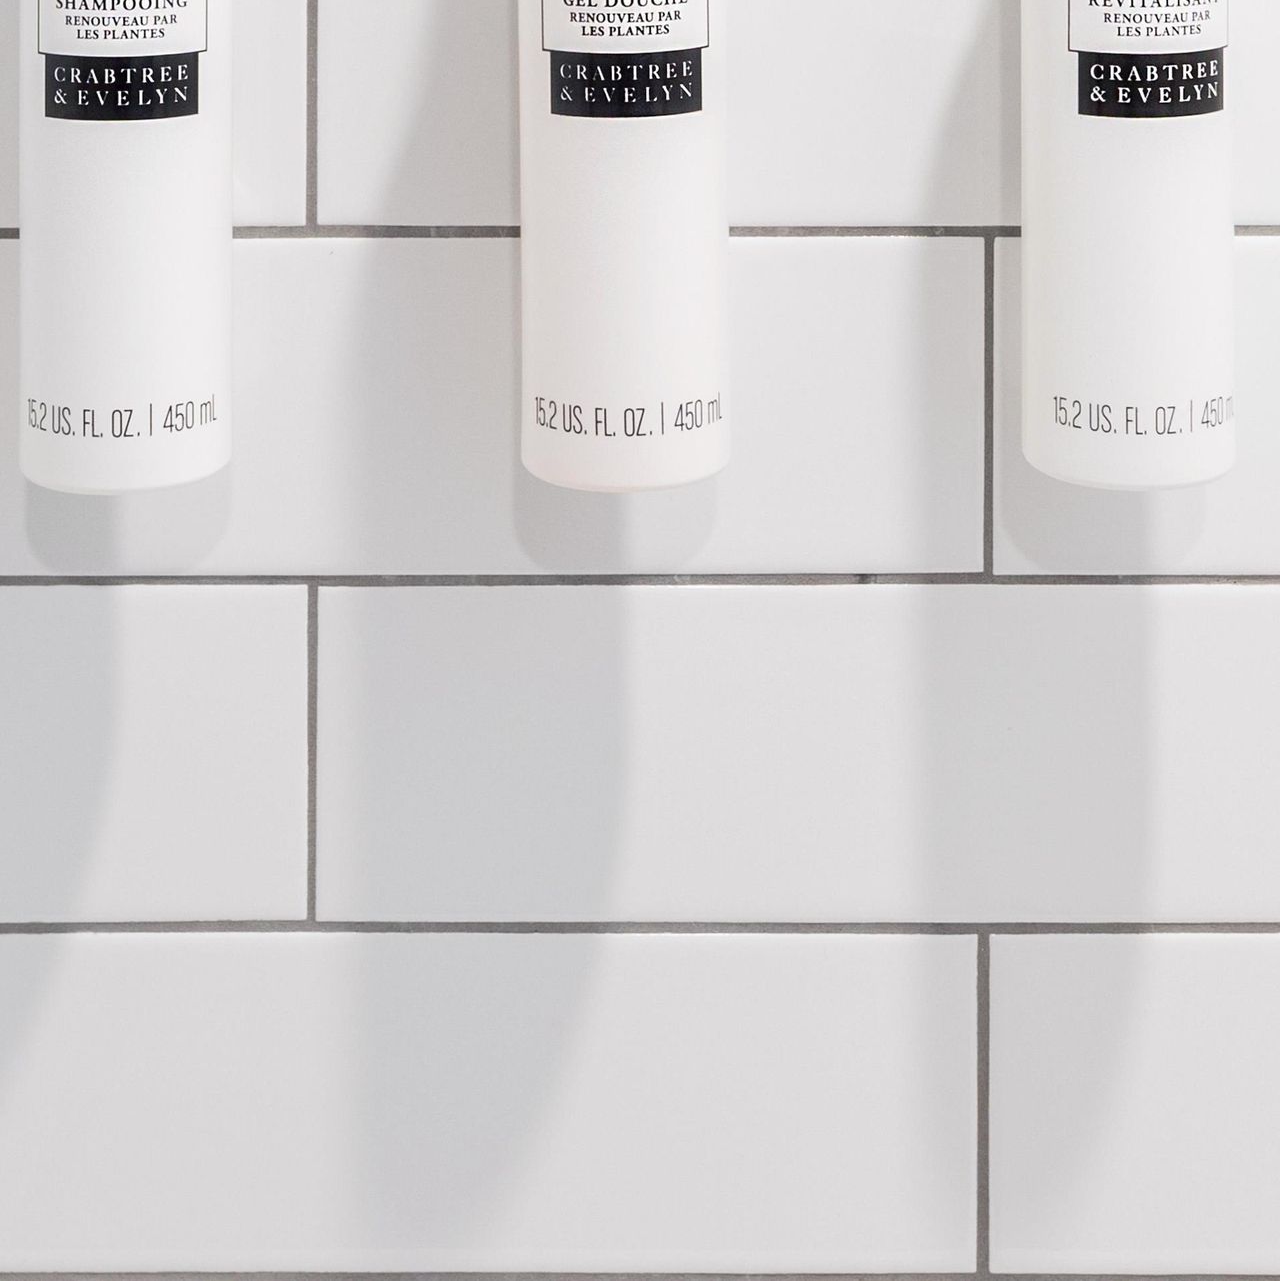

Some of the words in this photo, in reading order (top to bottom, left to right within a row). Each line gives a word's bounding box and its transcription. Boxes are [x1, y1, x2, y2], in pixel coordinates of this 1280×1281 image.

[65, 15, 148, 27] RENOUVEAU
[153, 15, 177, 25] PAR
[570, 12, 653, 23] RENOUVEAU
[658, 11, 681, 21] PAR
[1104, 13, 1188, 24] RENOUVEAU
[1192, 11, 1211, 21] PAR
[76, 29, 99, 40] LES
[103, 28, 165, 40] PLANTES
[581, 26, 605, 36] LES
[608, 25, 670, 36] PLANTES
[1117, 27, 1141, 37] LES
[1146, 25, 1202, 37] PLANTES
[54, 64, 189, 84] CRABTREE
[559, 61, 693, 81] CRABTREE
[1090, 60, 1219, 81] CRABTREE
[54, 89, 68, 105] &
[77, 86, 188, 106] EVELYN
[560, 86, 573, 101] &
[584, 82, 693, 103] EVELYN
[1090, 87, 1106, 102] &
[1118, 82, 1218, 103] EVELYN
[28, 398, 47, 431] 15.2
[52, 405, 75, 436] US.
[83, 409, 103, 437] FL.
[111, 409, 140, 438] OZ.
[163, 401, 194, 432] 450
[535, 397, 557, 429] 15.2
[562, 403, 587, 435] US.
[595, 408, 616, 436] FL.
[624, 408, 652, 437] OZ.
[674, 399, 703, 431] 450
[1053, 396, 1082, 429] 15.2
[1089, 403, 1116, 433] US.
[1126, 407, 1147, 435] FL.
[1155, 407, 1182, 435] OZ.
[1201, 397, 1223, 428] 450
